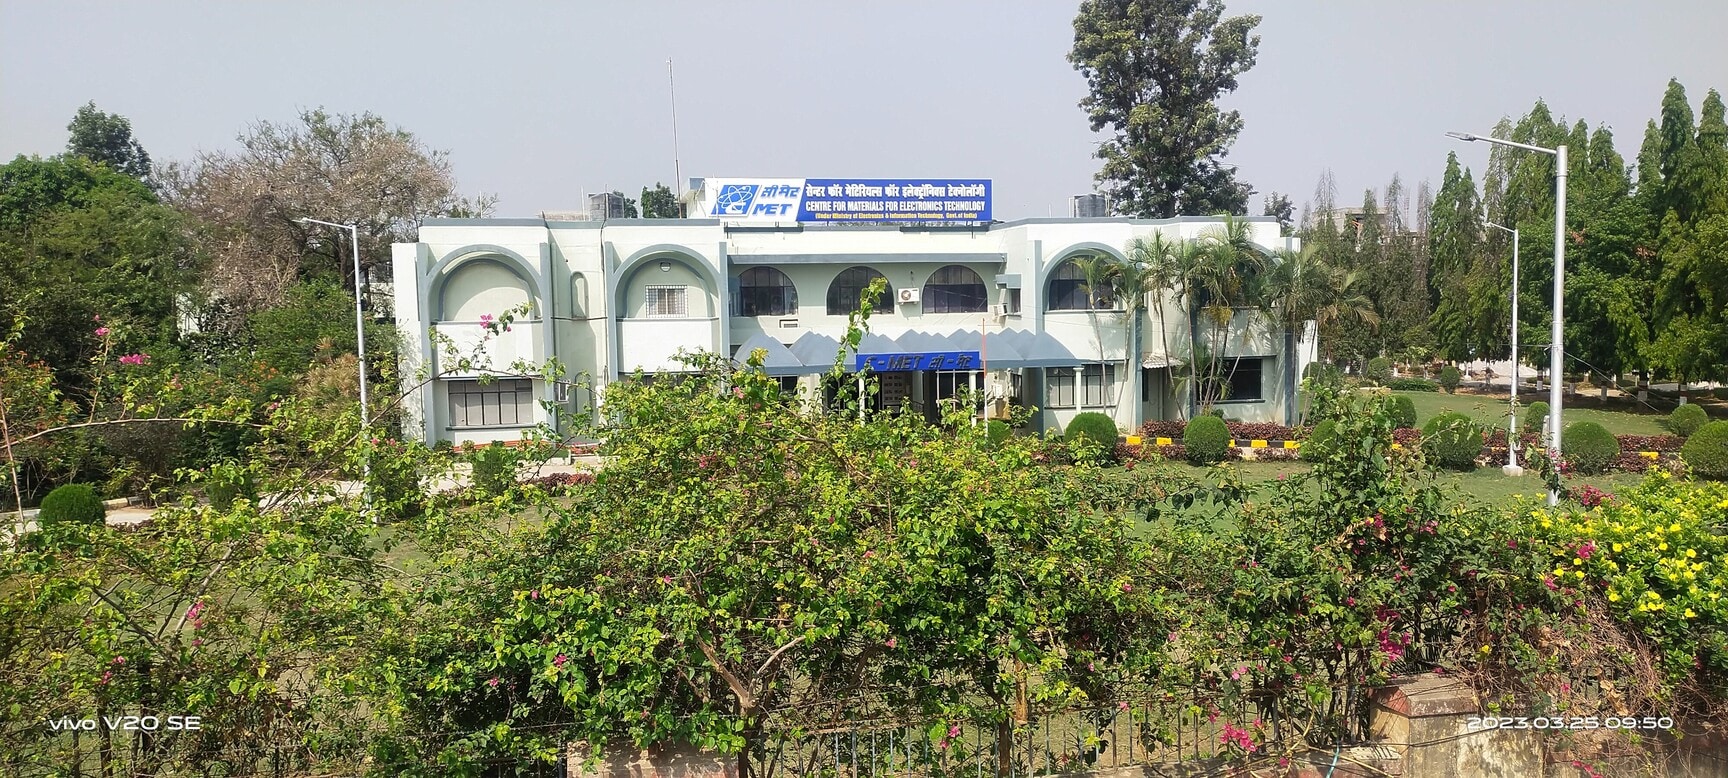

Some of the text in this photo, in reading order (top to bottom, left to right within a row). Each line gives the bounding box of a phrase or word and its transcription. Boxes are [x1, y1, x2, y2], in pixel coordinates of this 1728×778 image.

[828, 184, 843, 197] फॉर
[885, 184, 900, 197] फॉर
[752, 204, 792, 215] MET
[806, 201, 985, 212] CENTRE FOR MATERIALS FOR ELECTRONICS TECHNOLOGY
